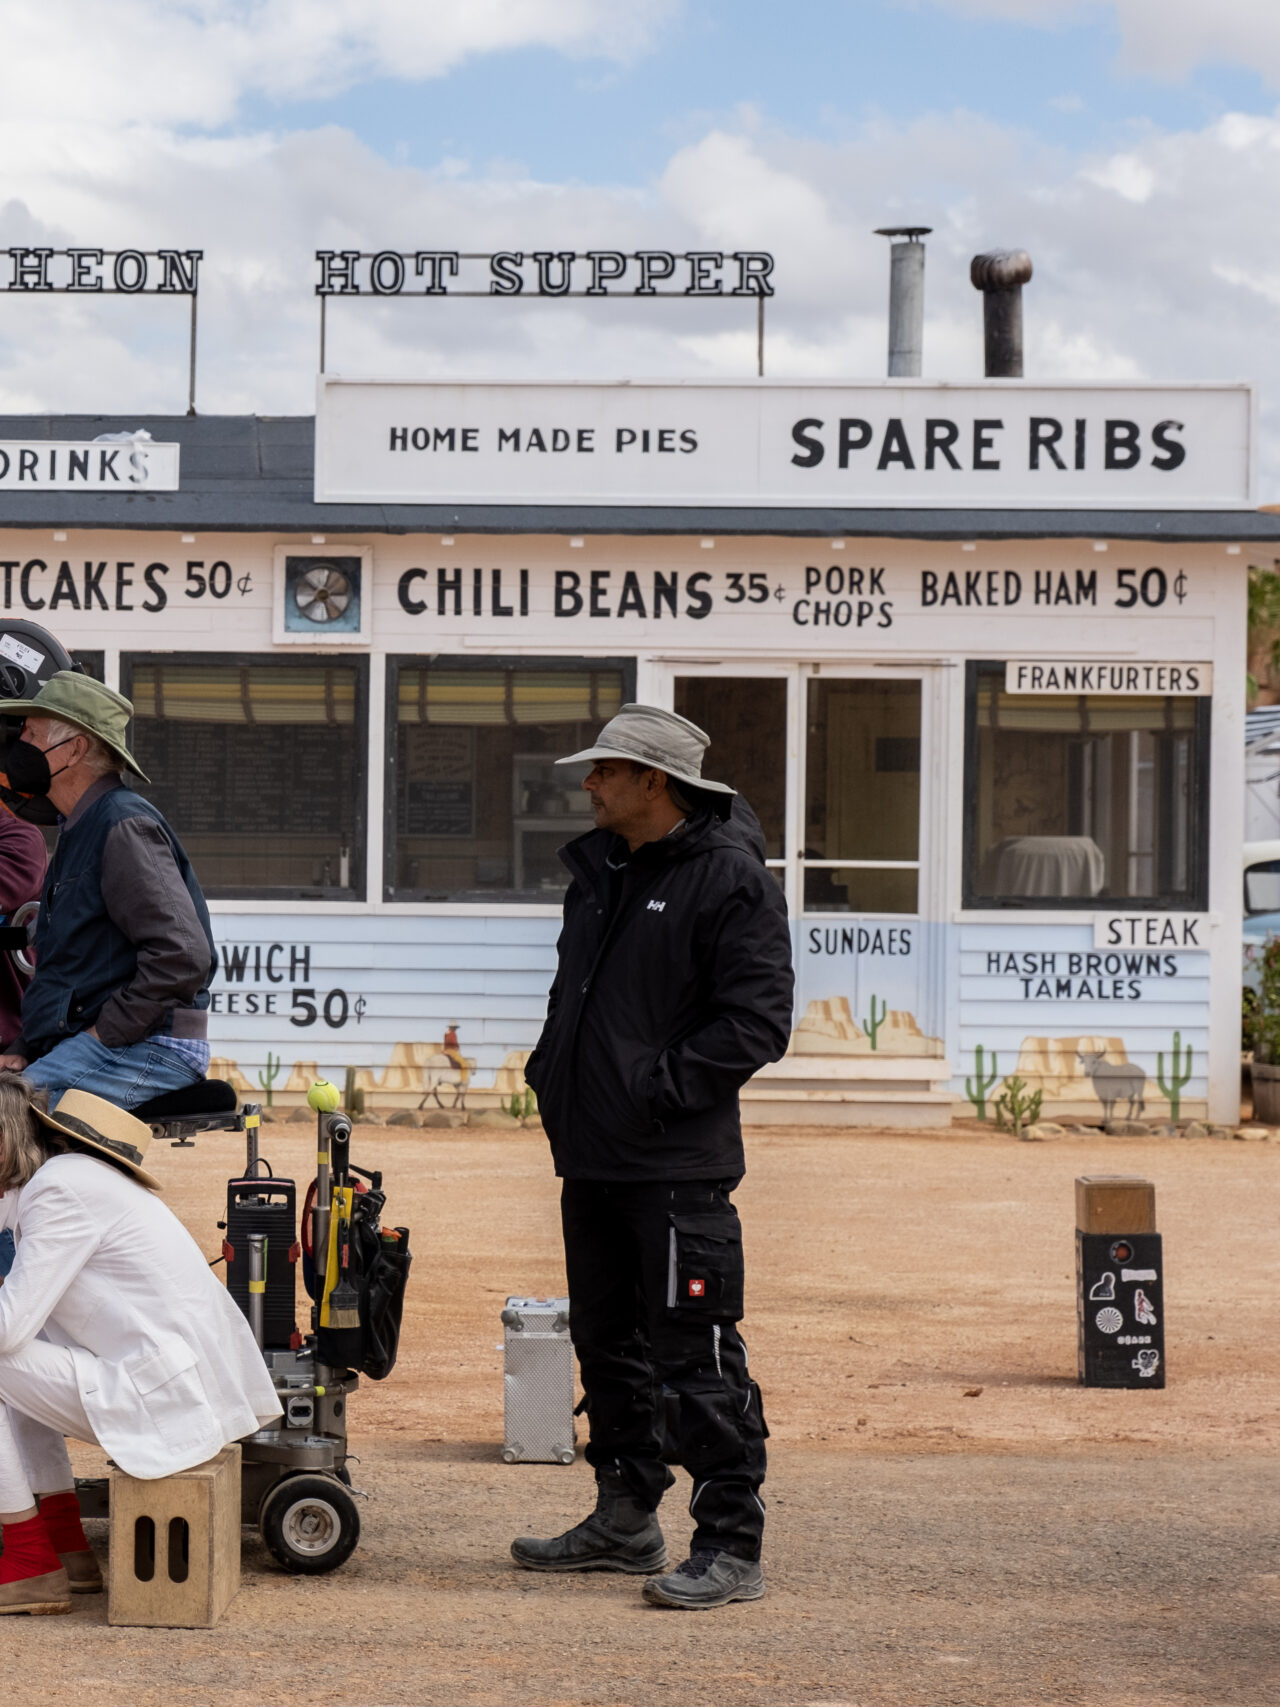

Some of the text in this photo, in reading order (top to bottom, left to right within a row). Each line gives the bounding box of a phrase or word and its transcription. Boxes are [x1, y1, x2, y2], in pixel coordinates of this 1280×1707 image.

[316, 250, 774, 296] HOT SUPPER
[389, 427, 698, 453] HOME MADE PIES
[791, 416, 1186, 471] SPARE RIBS
[184, 560, 253, 599] 50¢
[397, 567, 786, 620] CHILI BEANS 35¢
[805, 566, 886, 596] PORK
[921, 567, 1188, 608] BAKED HAM 50¢
[793, 599, 893, 628] CHOPS
[1018, 666, 1199, 691] FRANKFURTERS
[647, 900, 666, 912] HH
[809, 927, 911, 956] SUNDAES
[1107, 917, 1199, 946] STEAK
[221, 943, 310, 983] WICH
[987, 952, 1177, 977] HASH BROWNS
[1020, 978, 1142, 1000] TAMALES
[210, 988, 366, 1028] EESE 50¢
